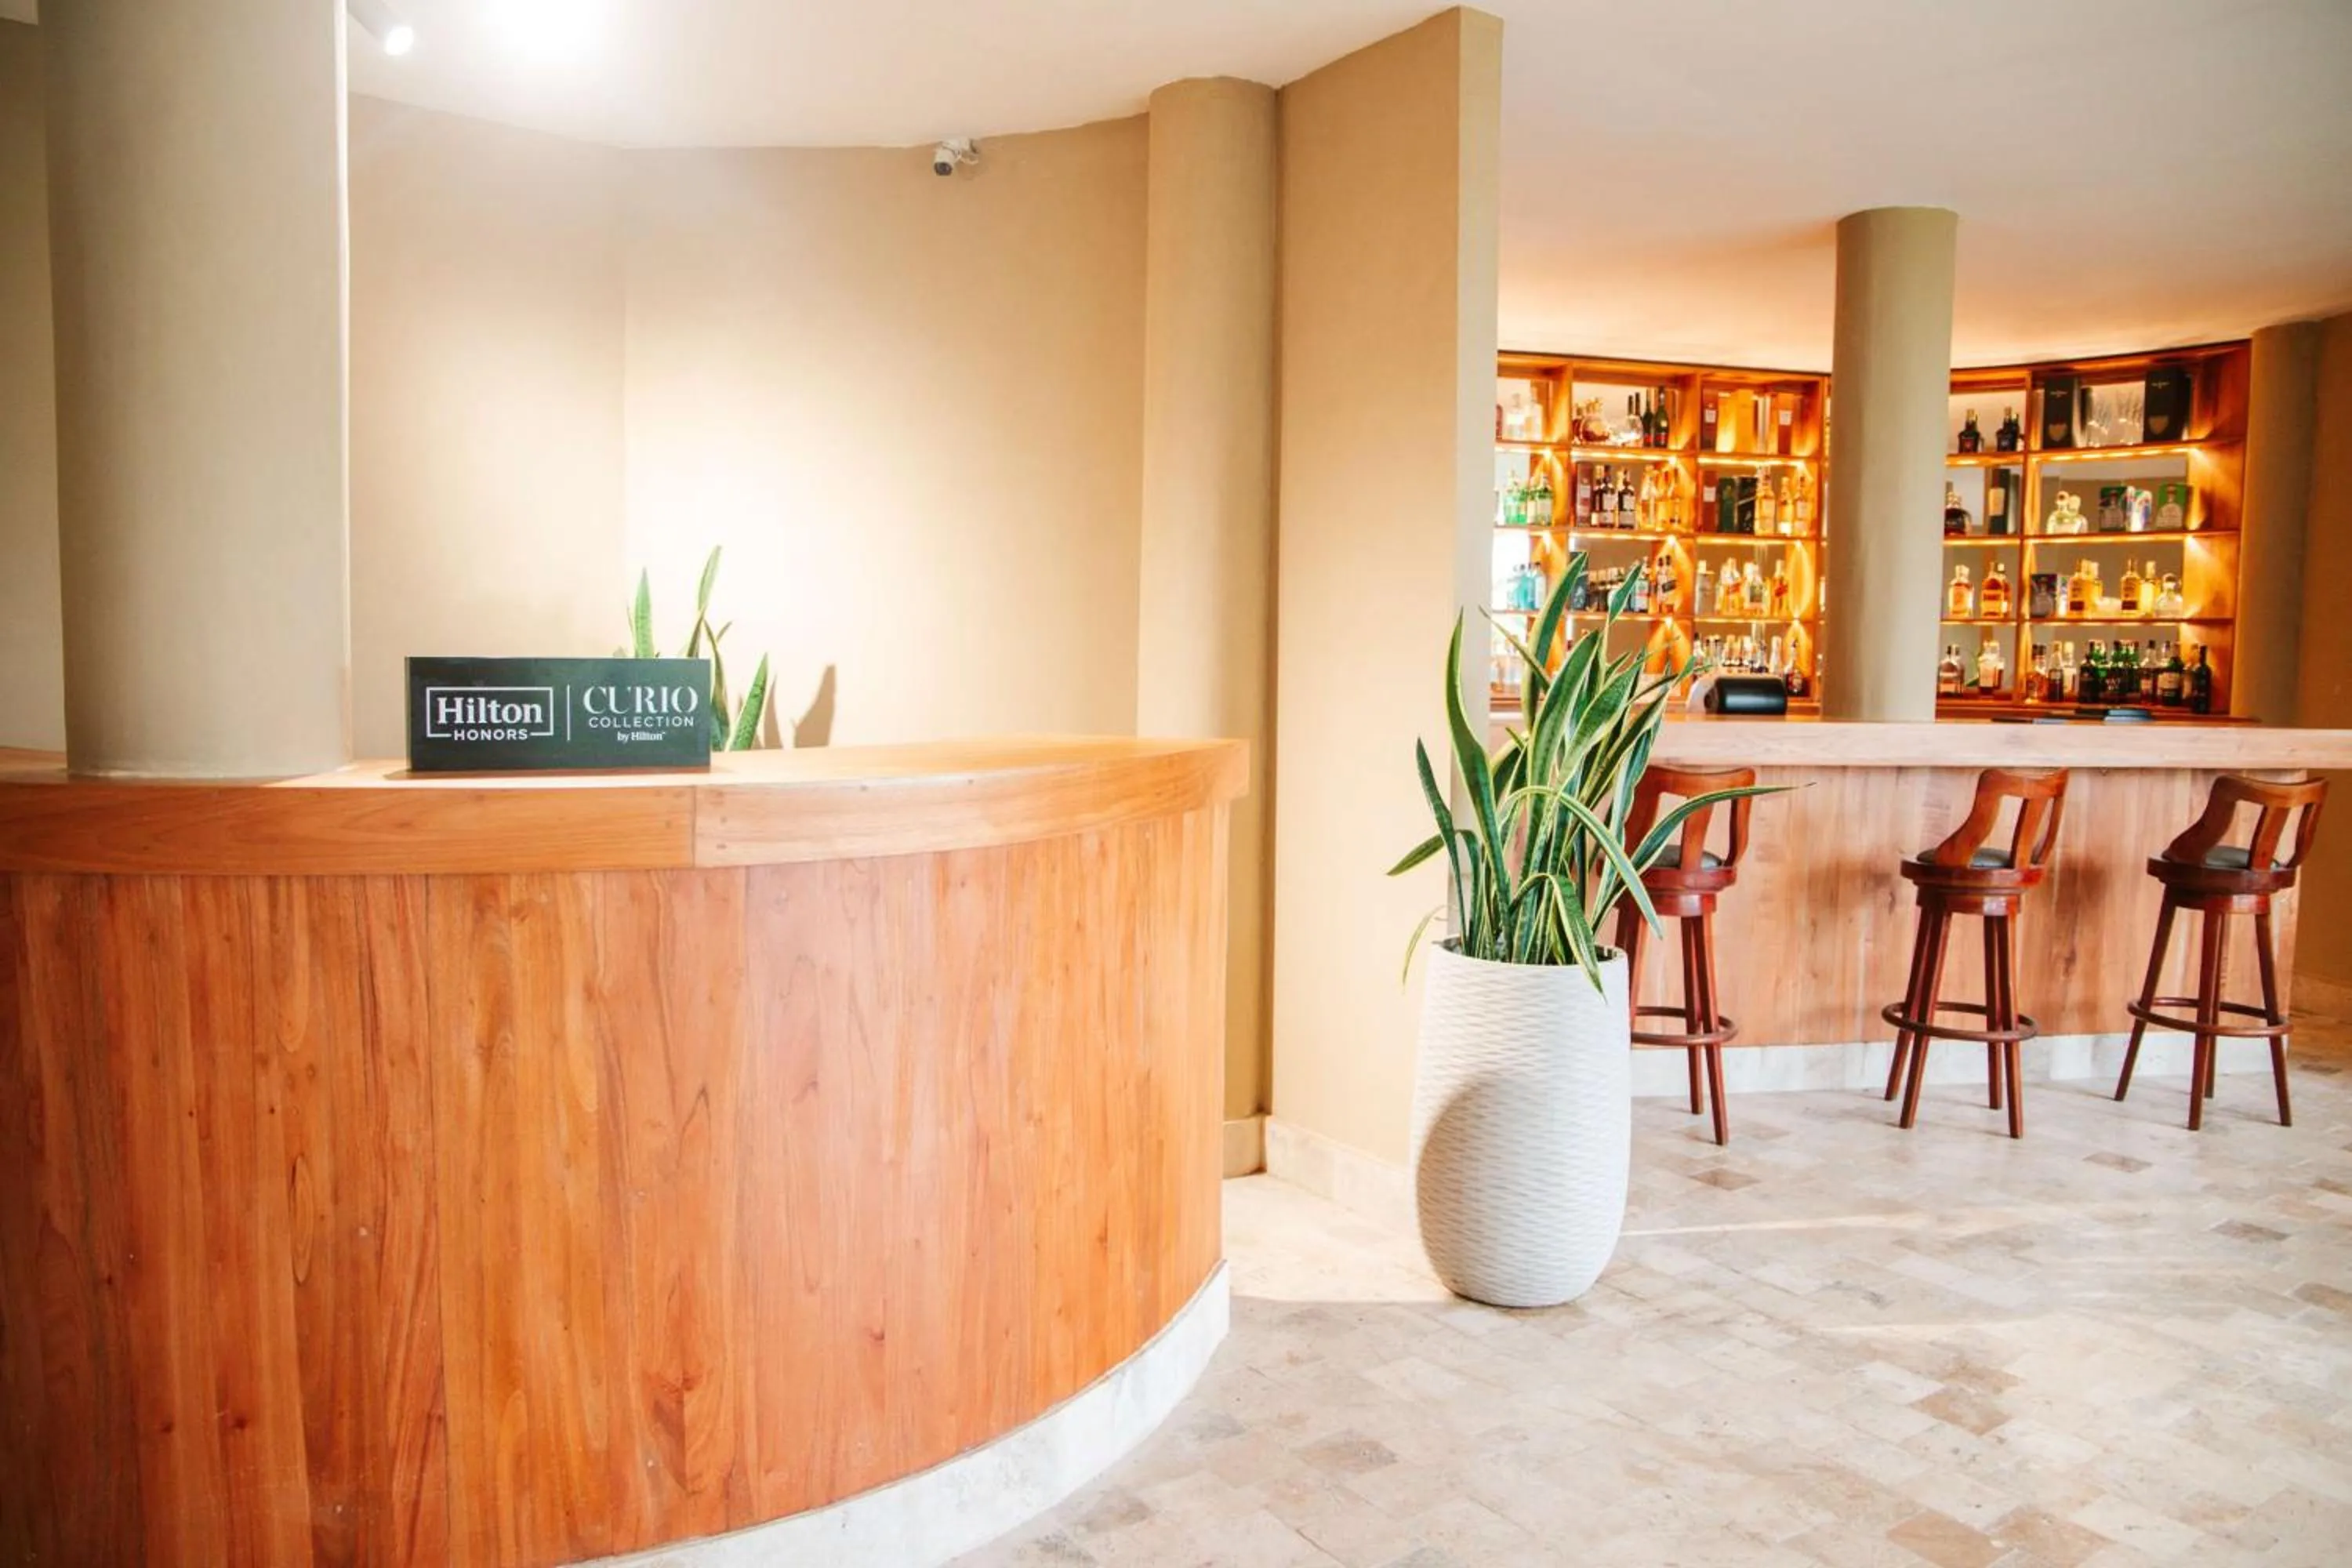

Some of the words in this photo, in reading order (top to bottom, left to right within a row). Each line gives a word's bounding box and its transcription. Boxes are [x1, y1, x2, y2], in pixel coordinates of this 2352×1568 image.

[583, 685, 698, 714] CURIO
[437, 697, 543, 724] Hilton
[589, 716, 694, 728] COLLECTION
[454, 728, 528, 741] HONORS
[617, 731, 629, 743] by
[631, 731, 663, 741] Hilton
